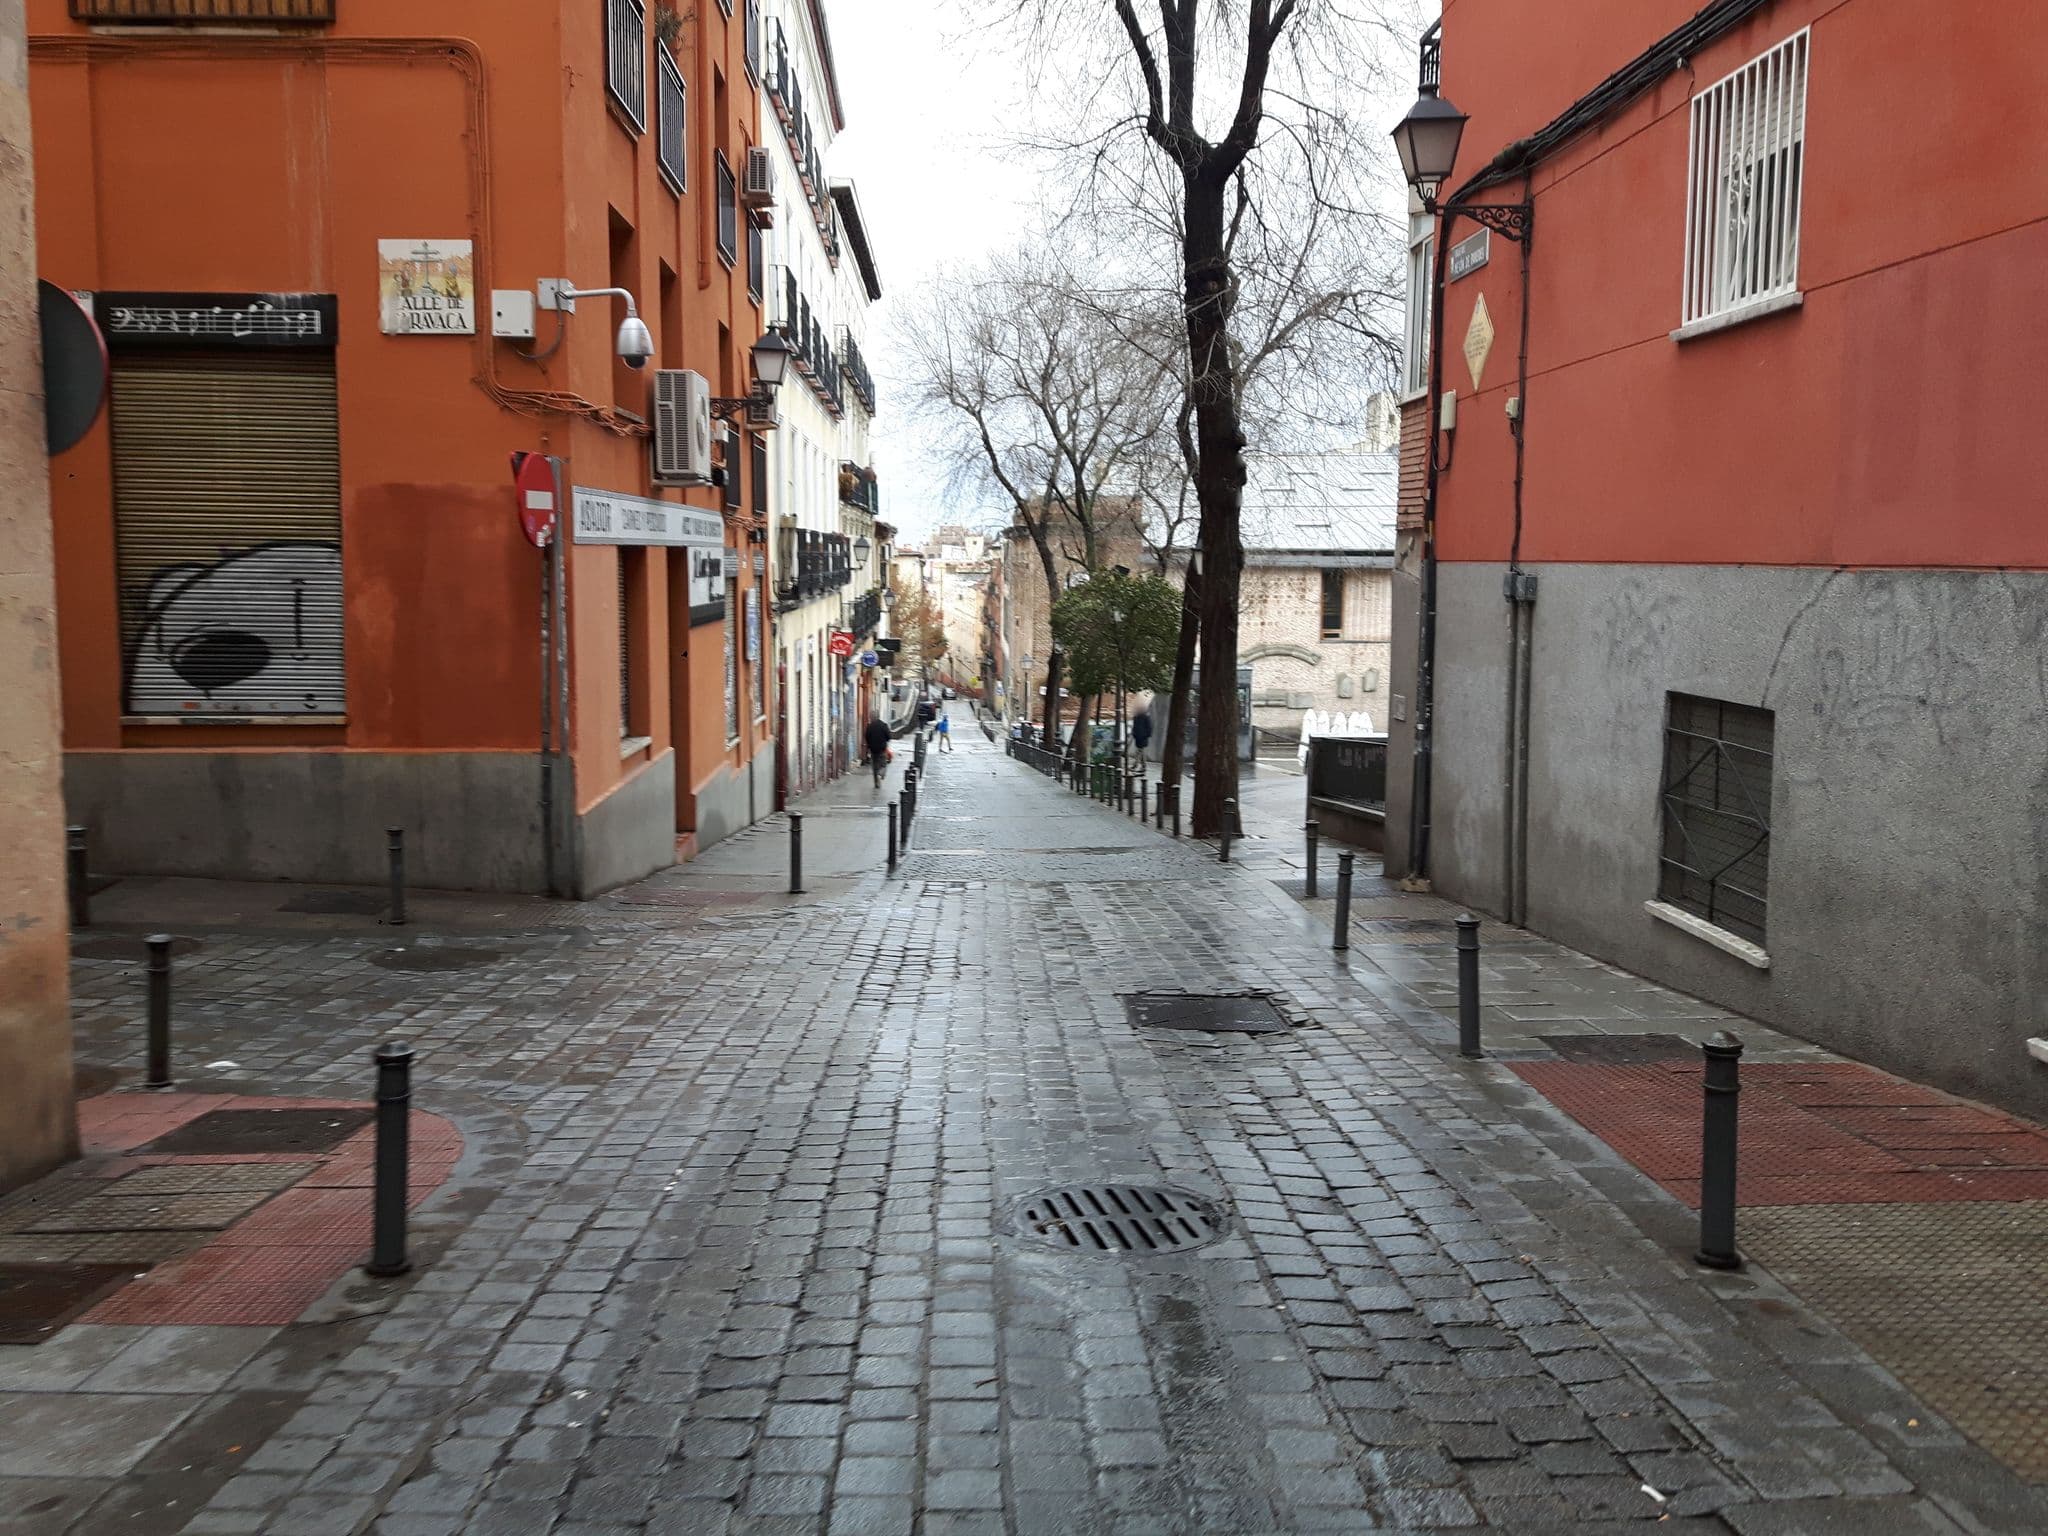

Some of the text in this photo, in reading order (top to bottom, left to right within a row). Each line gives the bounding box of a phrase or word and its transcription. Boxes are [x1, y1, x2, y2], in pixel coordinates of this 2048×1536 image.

[396, 296, 464, 310] ALLE DE
[396, 312, 468, 329] RAVACA
